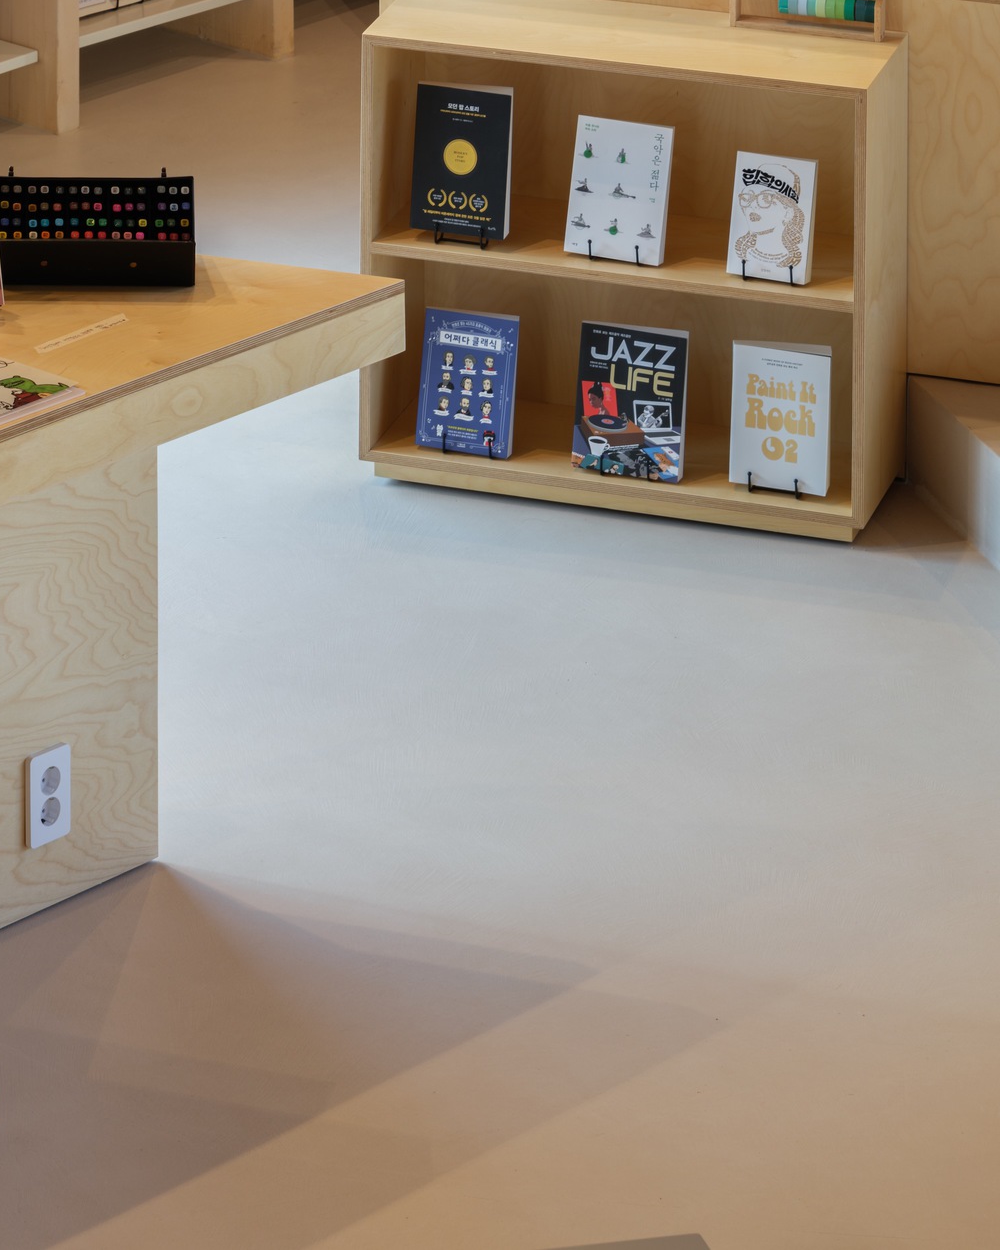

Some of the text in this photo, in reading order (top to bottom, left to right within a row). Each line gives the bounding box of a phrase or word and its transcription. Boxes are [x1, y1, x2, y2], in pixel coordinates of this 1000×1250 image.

[464, 105, 479, 113] 스토리
[649, 133, 664, 192] 국악은 젊다
[444, 333, 497, 349] 어쩌다 클래식
[590, 336, 676, 372] JAZZ
[610, 363, 675, 398] LIFE
[746, 373, 816, 405] Paint It
[745, 397, 815, 438] Rock
